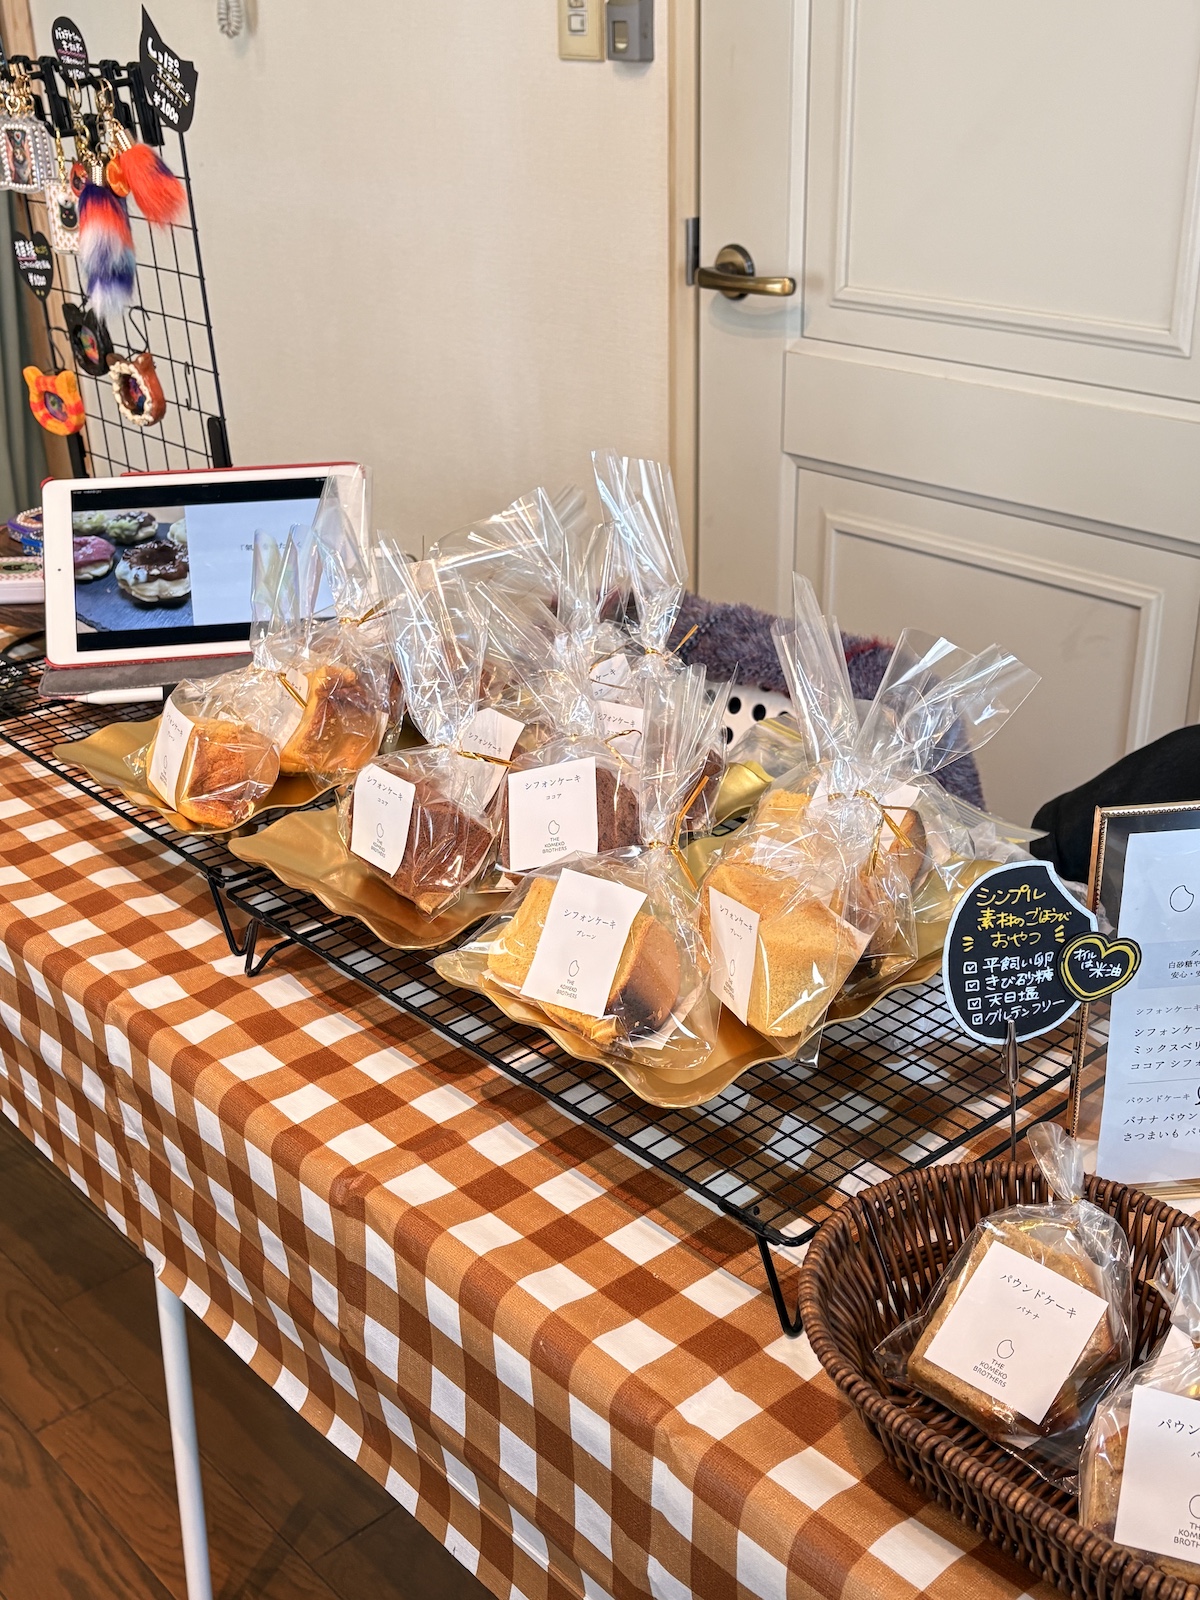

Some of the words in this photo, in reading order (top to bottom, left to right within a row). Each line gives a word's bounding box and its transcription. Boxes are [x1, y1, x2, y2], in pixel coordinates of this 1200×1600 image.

[147, 36, 180, 79] しっぽの
[468, 732, 502, 753] シフォンケーキ
[366, 775, 404, 802] シフォンケーキ
[525, 774, 581, 791] シフォンケーキ
[546, 793, 562, 801] ココア
[542, 846, 568, 854] BROTHERS
[544, 841, 566, 849] KOMEKO
[976, 884, 1046, 907] シンプル
[563, 908, 617, 930] シフォンケーキ
[719, 904, 753, 934] シフォンケーキ
[976, 906, 1073, 932] 素材のごほうび
[990, 931, 1042, 949] おやつ
[1073, 948, 1097, 961] オイル
[1190, 949, 1200, 958] グ
[982, 951, 1055, 974] 平飼い卵
[1081, 960, 1094, 970] は
[1088, 962, 1122, 979] 米油
[984, 967, 1055, 991] きび砂糖
[984, 985, 1040, 1008] 天日塩
[984, 998, 1066, 1026] グルテンフリー
[1131, 1061, 1165, 1071] ココア
[1123, 1115, 1159, 1126] バナナ
[1123, 1129, 1179, 1142] さつまいも
[1184, 1127, 1200, 1137] パ
[1000, 1273, 1077, 1319] パウンドケーキ
[1016, 1305, 1040, 1321] バナナ
[979, 1360, 1008, 1380] KOMEKO
[991, 1358, 1006, 1370] THE
[972, 1365, 1008, 1388] BROTHERS
[1158, 1419, 1200, 1435] パウン
[1178, 1528, 1200, 1540] KOM
